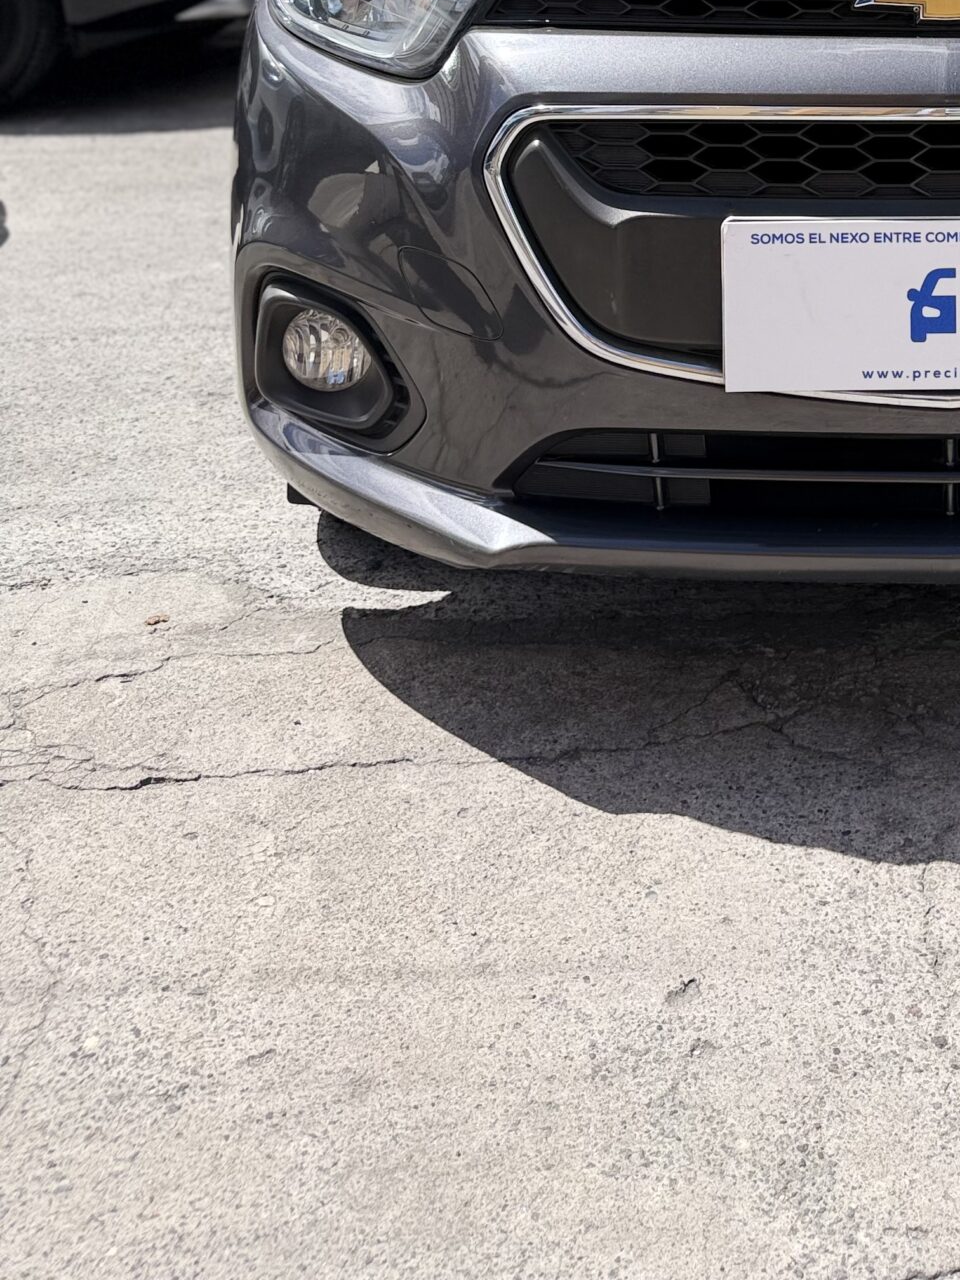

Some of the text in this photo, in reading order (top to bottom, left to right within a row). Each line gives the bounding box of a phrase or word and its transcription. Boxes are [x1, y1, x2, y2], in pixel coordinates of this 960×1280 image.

[750, 232, 806, 245] SOMOS
[808, 232, 827, 244] EL
[829, 231, 870, 244] NEXO
[873, 231, 922, 244] ENTRE
